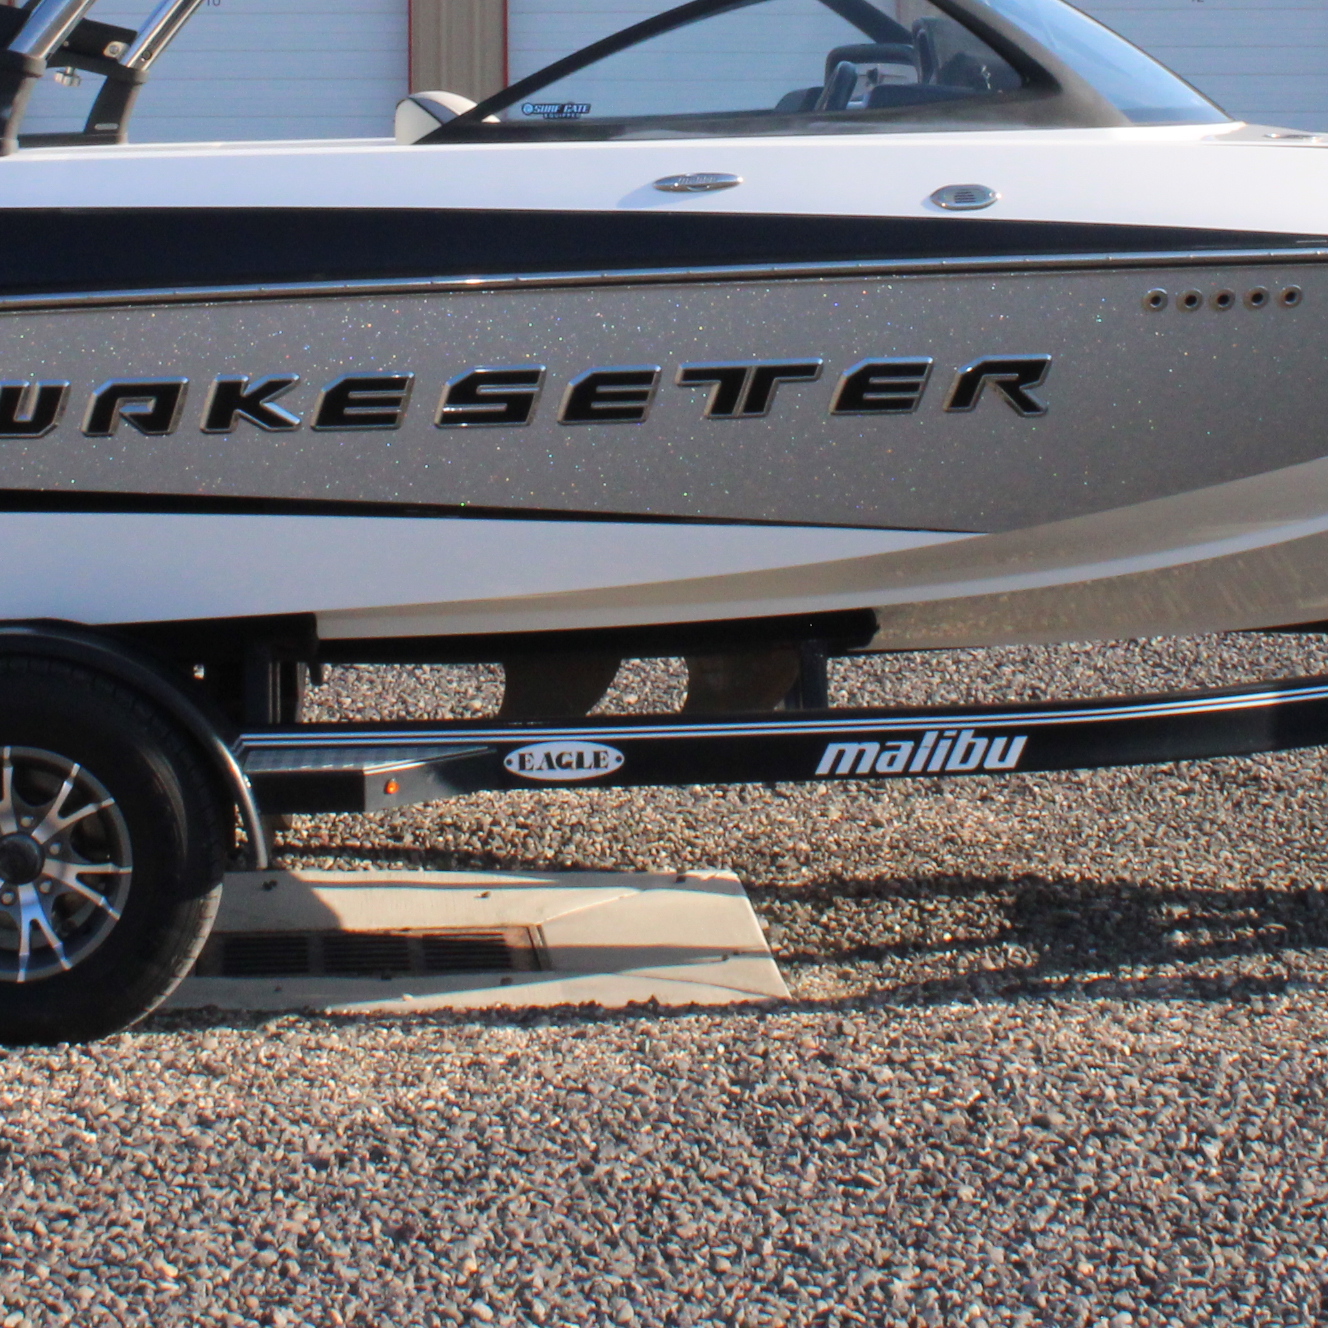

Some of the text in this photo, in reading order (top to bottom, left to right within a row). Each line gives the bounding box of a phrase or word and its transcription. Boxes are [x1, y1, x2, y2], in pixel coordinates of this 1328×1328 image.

[534, 103, 589, 113] SURF GATE
[517, 749, 611, 771] EAGLE
[814, 728, 1029, 776] malibu
